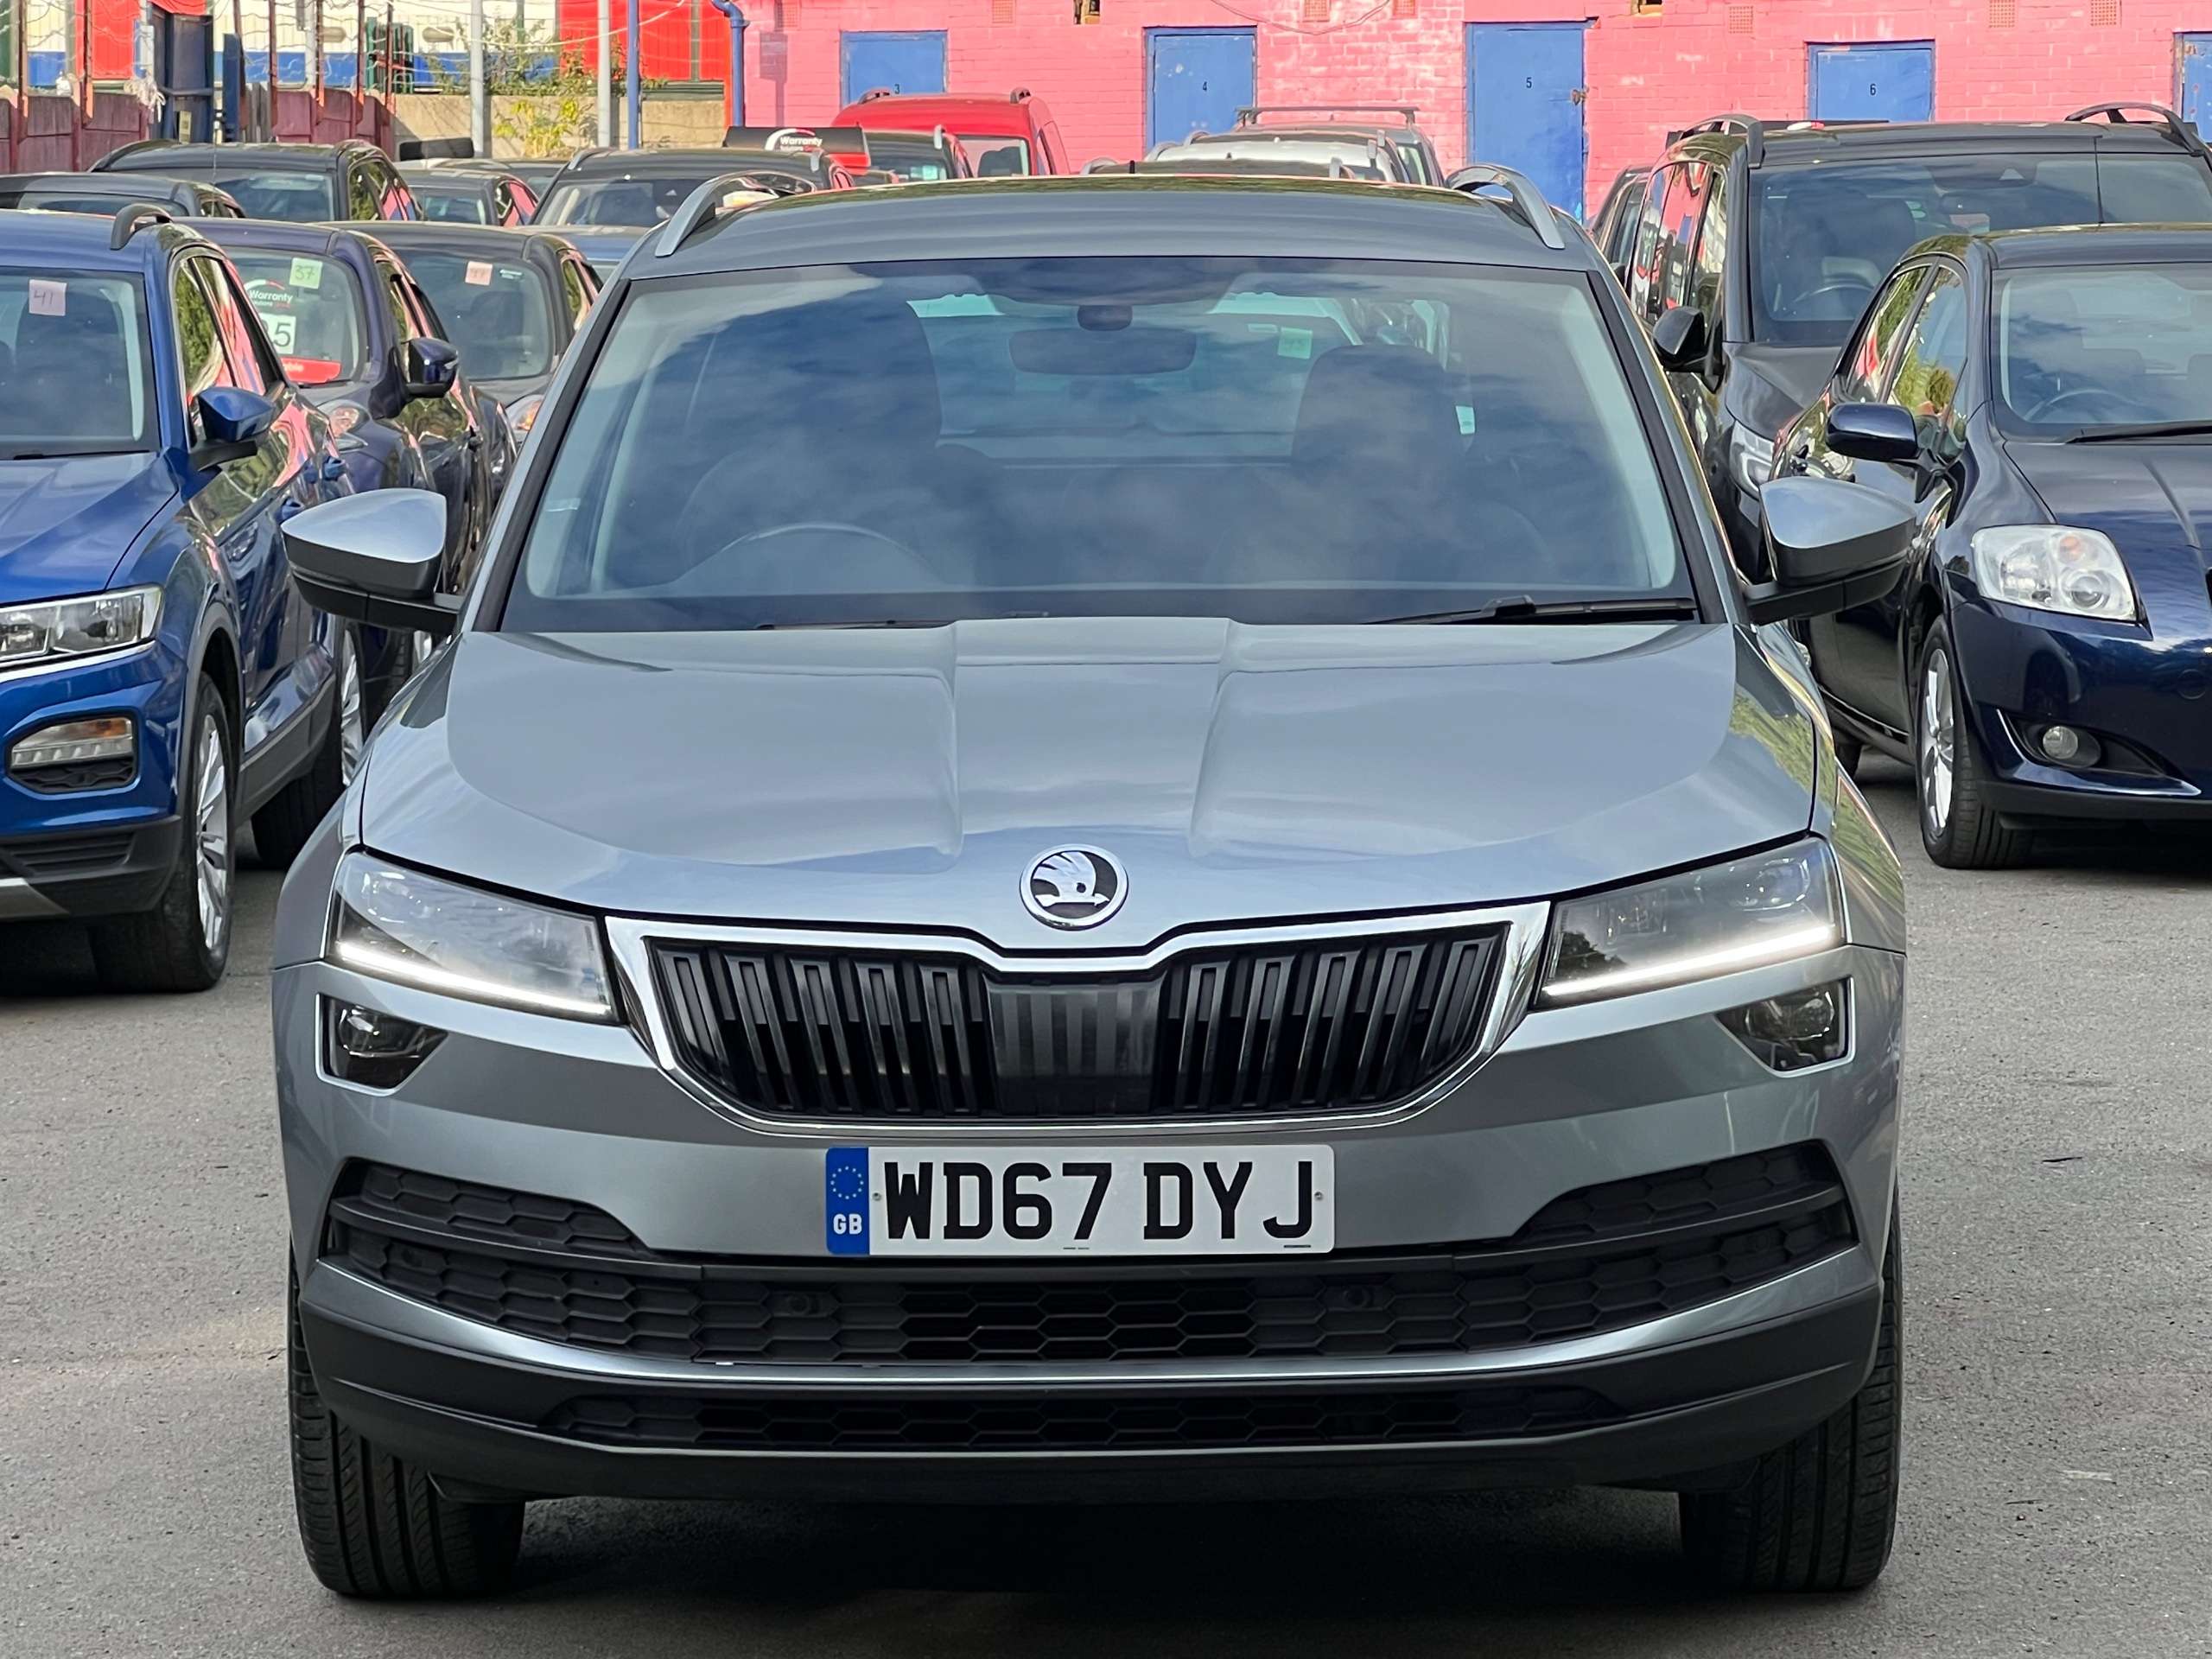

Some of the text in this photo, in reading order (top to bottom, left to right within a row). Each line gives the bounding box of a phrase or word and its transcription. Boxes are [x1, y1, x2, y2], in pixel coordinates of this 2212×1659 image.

[894, 84, 900, 94] 3
[1526, 77, 1532, 88] 5
[1870, 83, 1877, 96] 6
[779, 136, 823, 148] Warranty
[249, 289, 294, 304] Warranty
[884, 1160, 1313, 1240] WD67 DYJ
[833, 1213, 863, 1235] GB
